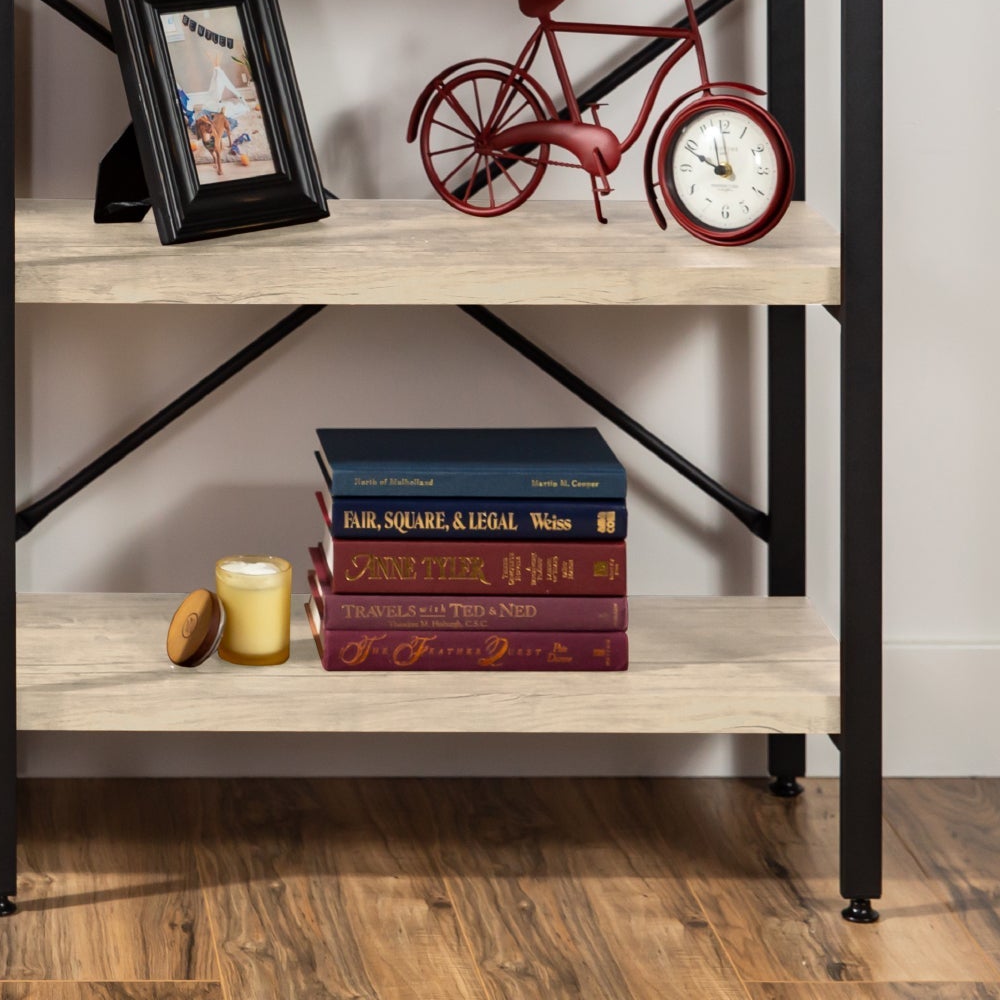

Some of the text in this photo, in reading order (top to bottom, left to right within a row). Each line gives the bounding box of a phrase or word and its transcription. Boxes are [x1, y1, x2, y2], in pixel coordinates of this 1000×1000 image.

[721, 205, 730, 219] 6
[343, 510, 519, 534] FAIR, SQUARE, & LEGAL
[529, 512, 573, 532] Weiss
[345, 553, 418, 582] ANNE
[421, 556, 492, 586] TYLER
[341, 603, 537, 619] TRAVELS with TED & NED
